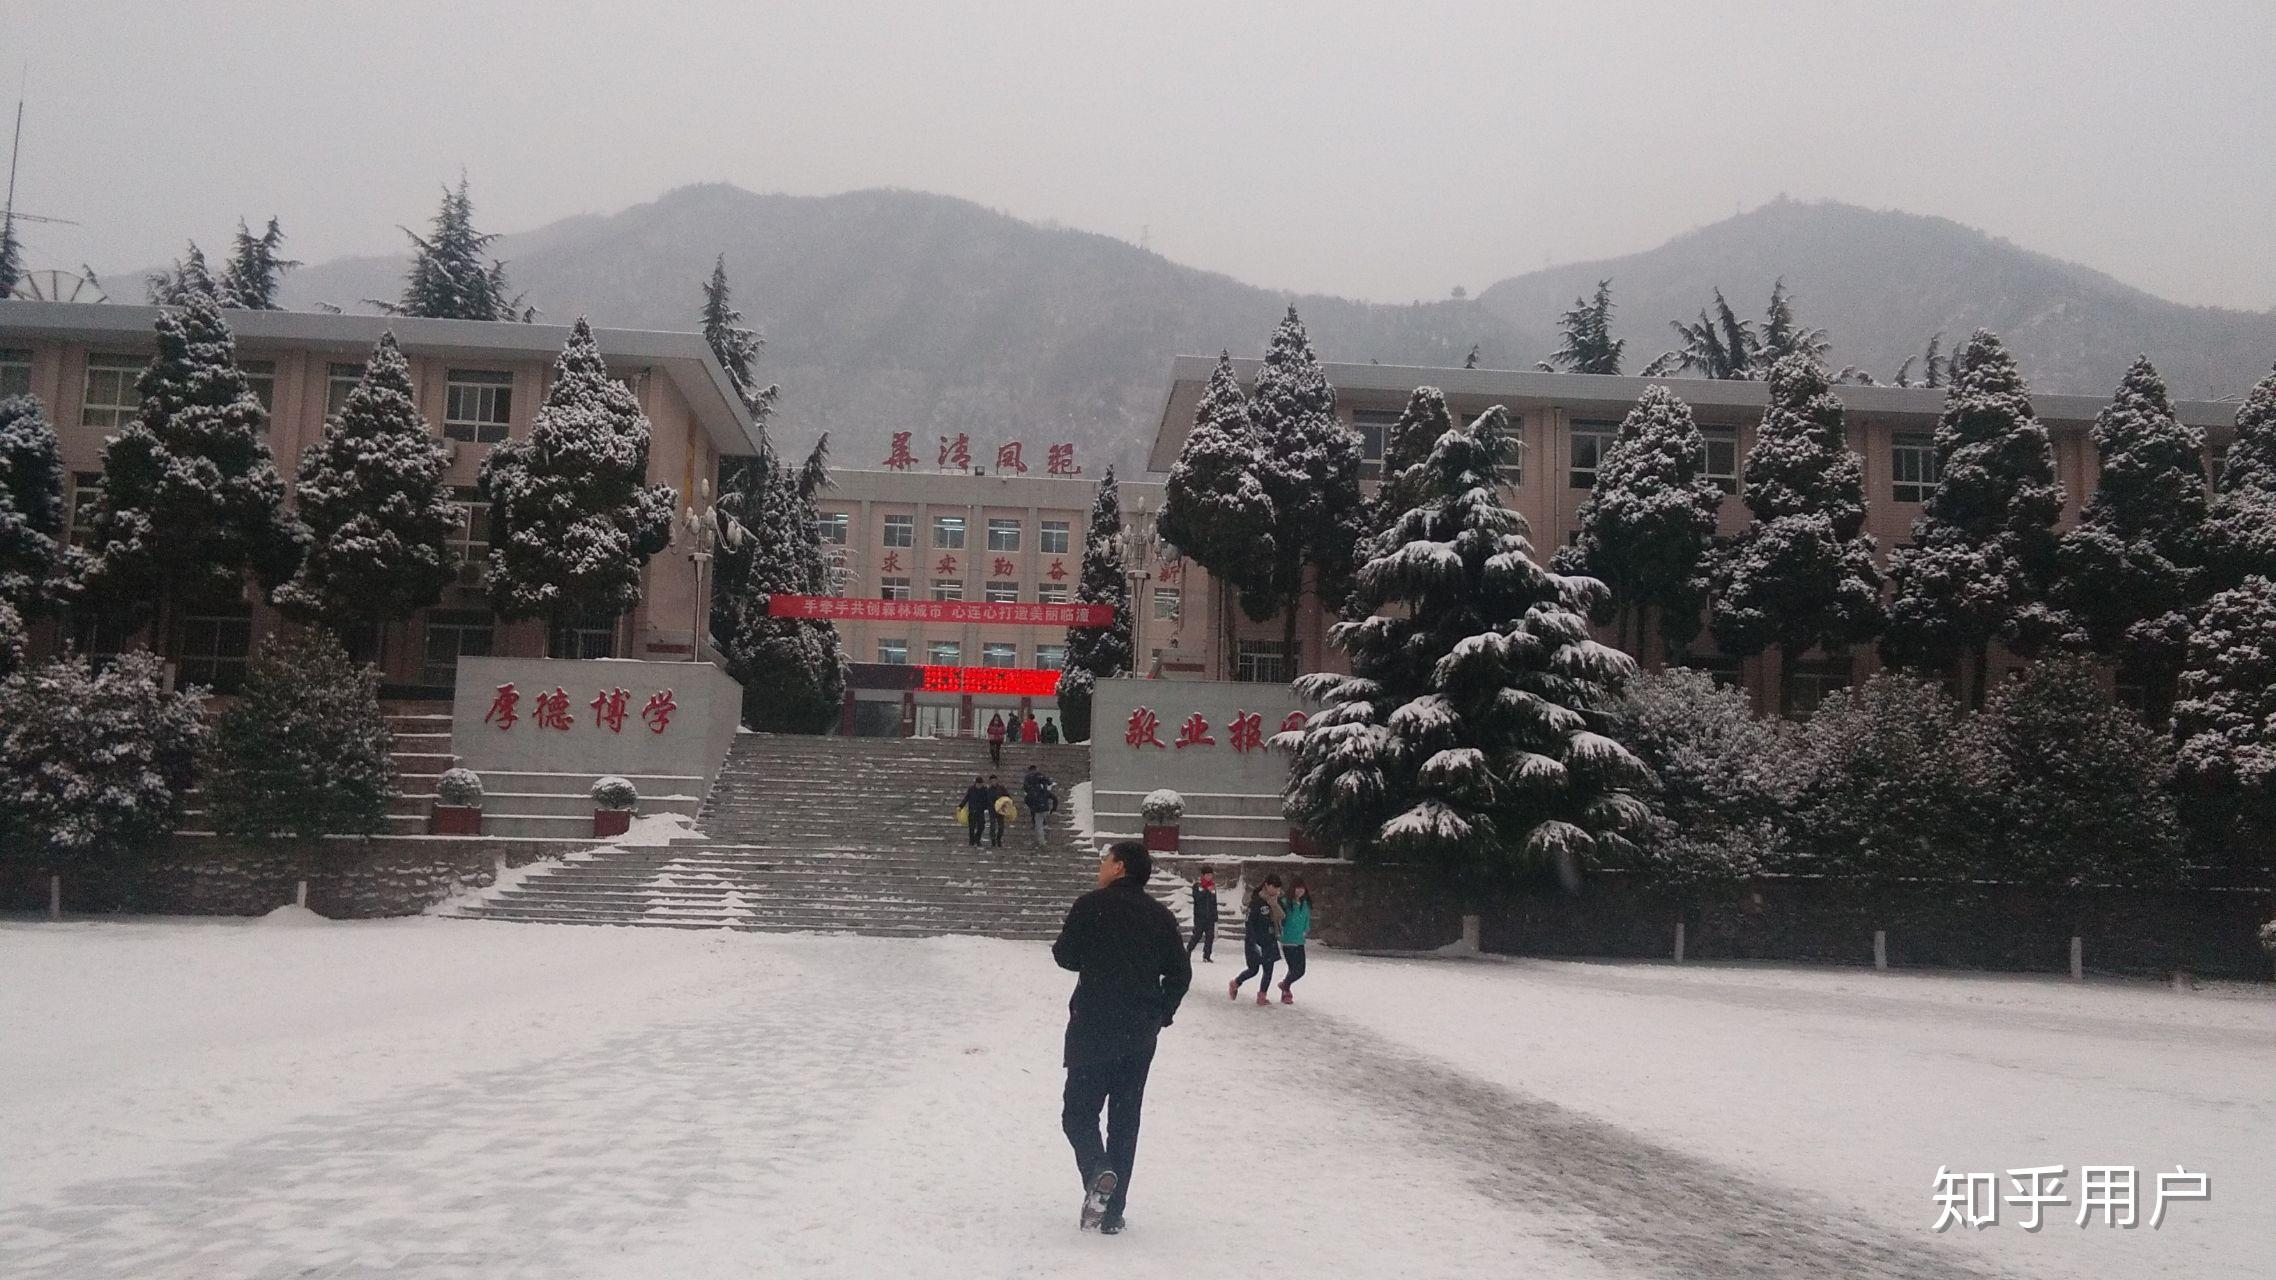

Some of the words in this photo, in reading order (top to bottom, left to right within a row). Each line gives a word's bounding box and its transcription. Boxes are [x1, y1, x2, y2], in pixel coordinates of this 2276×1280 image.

[834, 551, 1069, 581] 求实勤奋
[803, 599, 943, 618] 手牵手共创森林城市
[951, 605, 1090, 623] 心连心打造美丽临潼
[484, 681, 678, 735] 厚德博学
